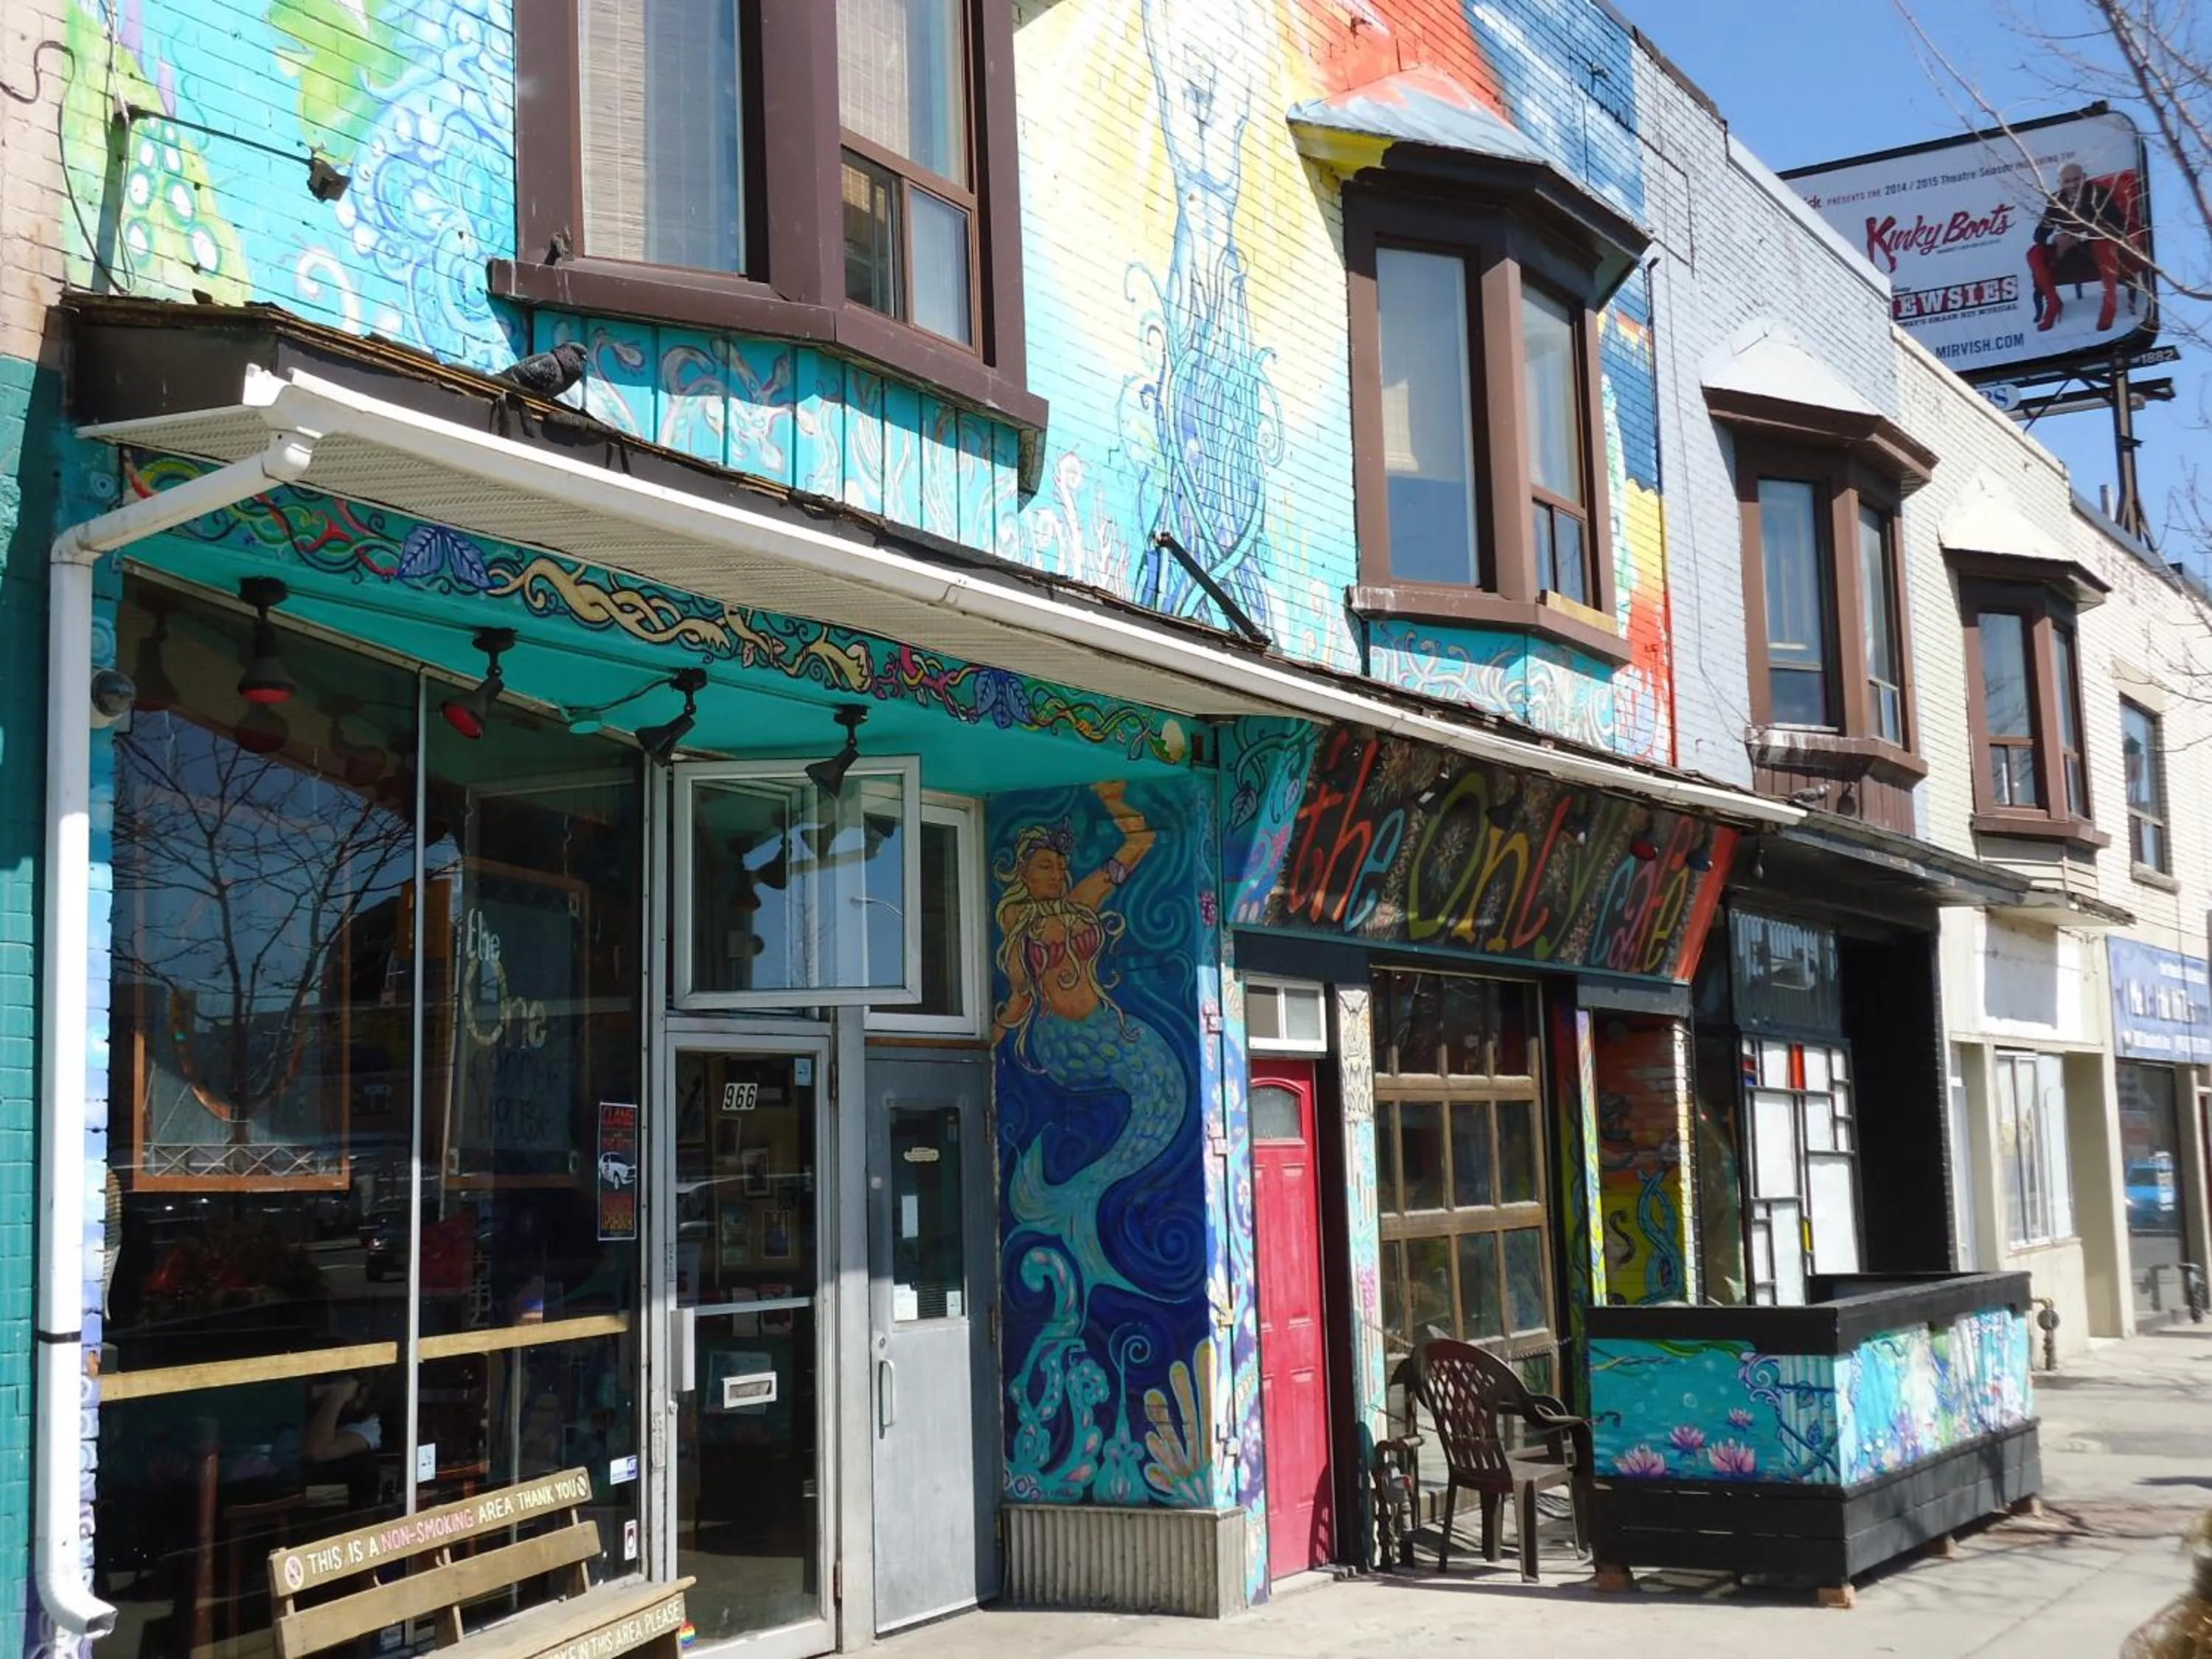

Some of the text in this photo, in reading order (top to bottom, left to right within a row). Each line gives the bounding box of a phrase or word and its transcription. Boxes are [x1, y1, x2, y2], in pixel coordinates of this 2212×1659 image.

[1826, 192, 1865, 206] PRESENTS
[1867, 189, 1882, 199] THE
[1885, 182, 1907, 196] 2014
[1916, 176, 1939, 191] 2015
[1940, 170, 1977, 186] Theatre
[1865, 204, 2017, 273] Kinky Boots
[1893, 275, 2018, 318] EWSIES
[1935, 333, 2025, 359] MIRVISH.COM
[1288, 731, 1405, 933] the
[1408, 771, 1622, 961] Only
[466, 908, 501, 961] the
[725, 1084, 757, 1108] 966
[307, 1477, 578, 1575] THIS IS A NON-SMOKING AREA THANK YOU
[590, 1631, 613, 1656] THIS
[614, 1618, 645, 1647] AREA
